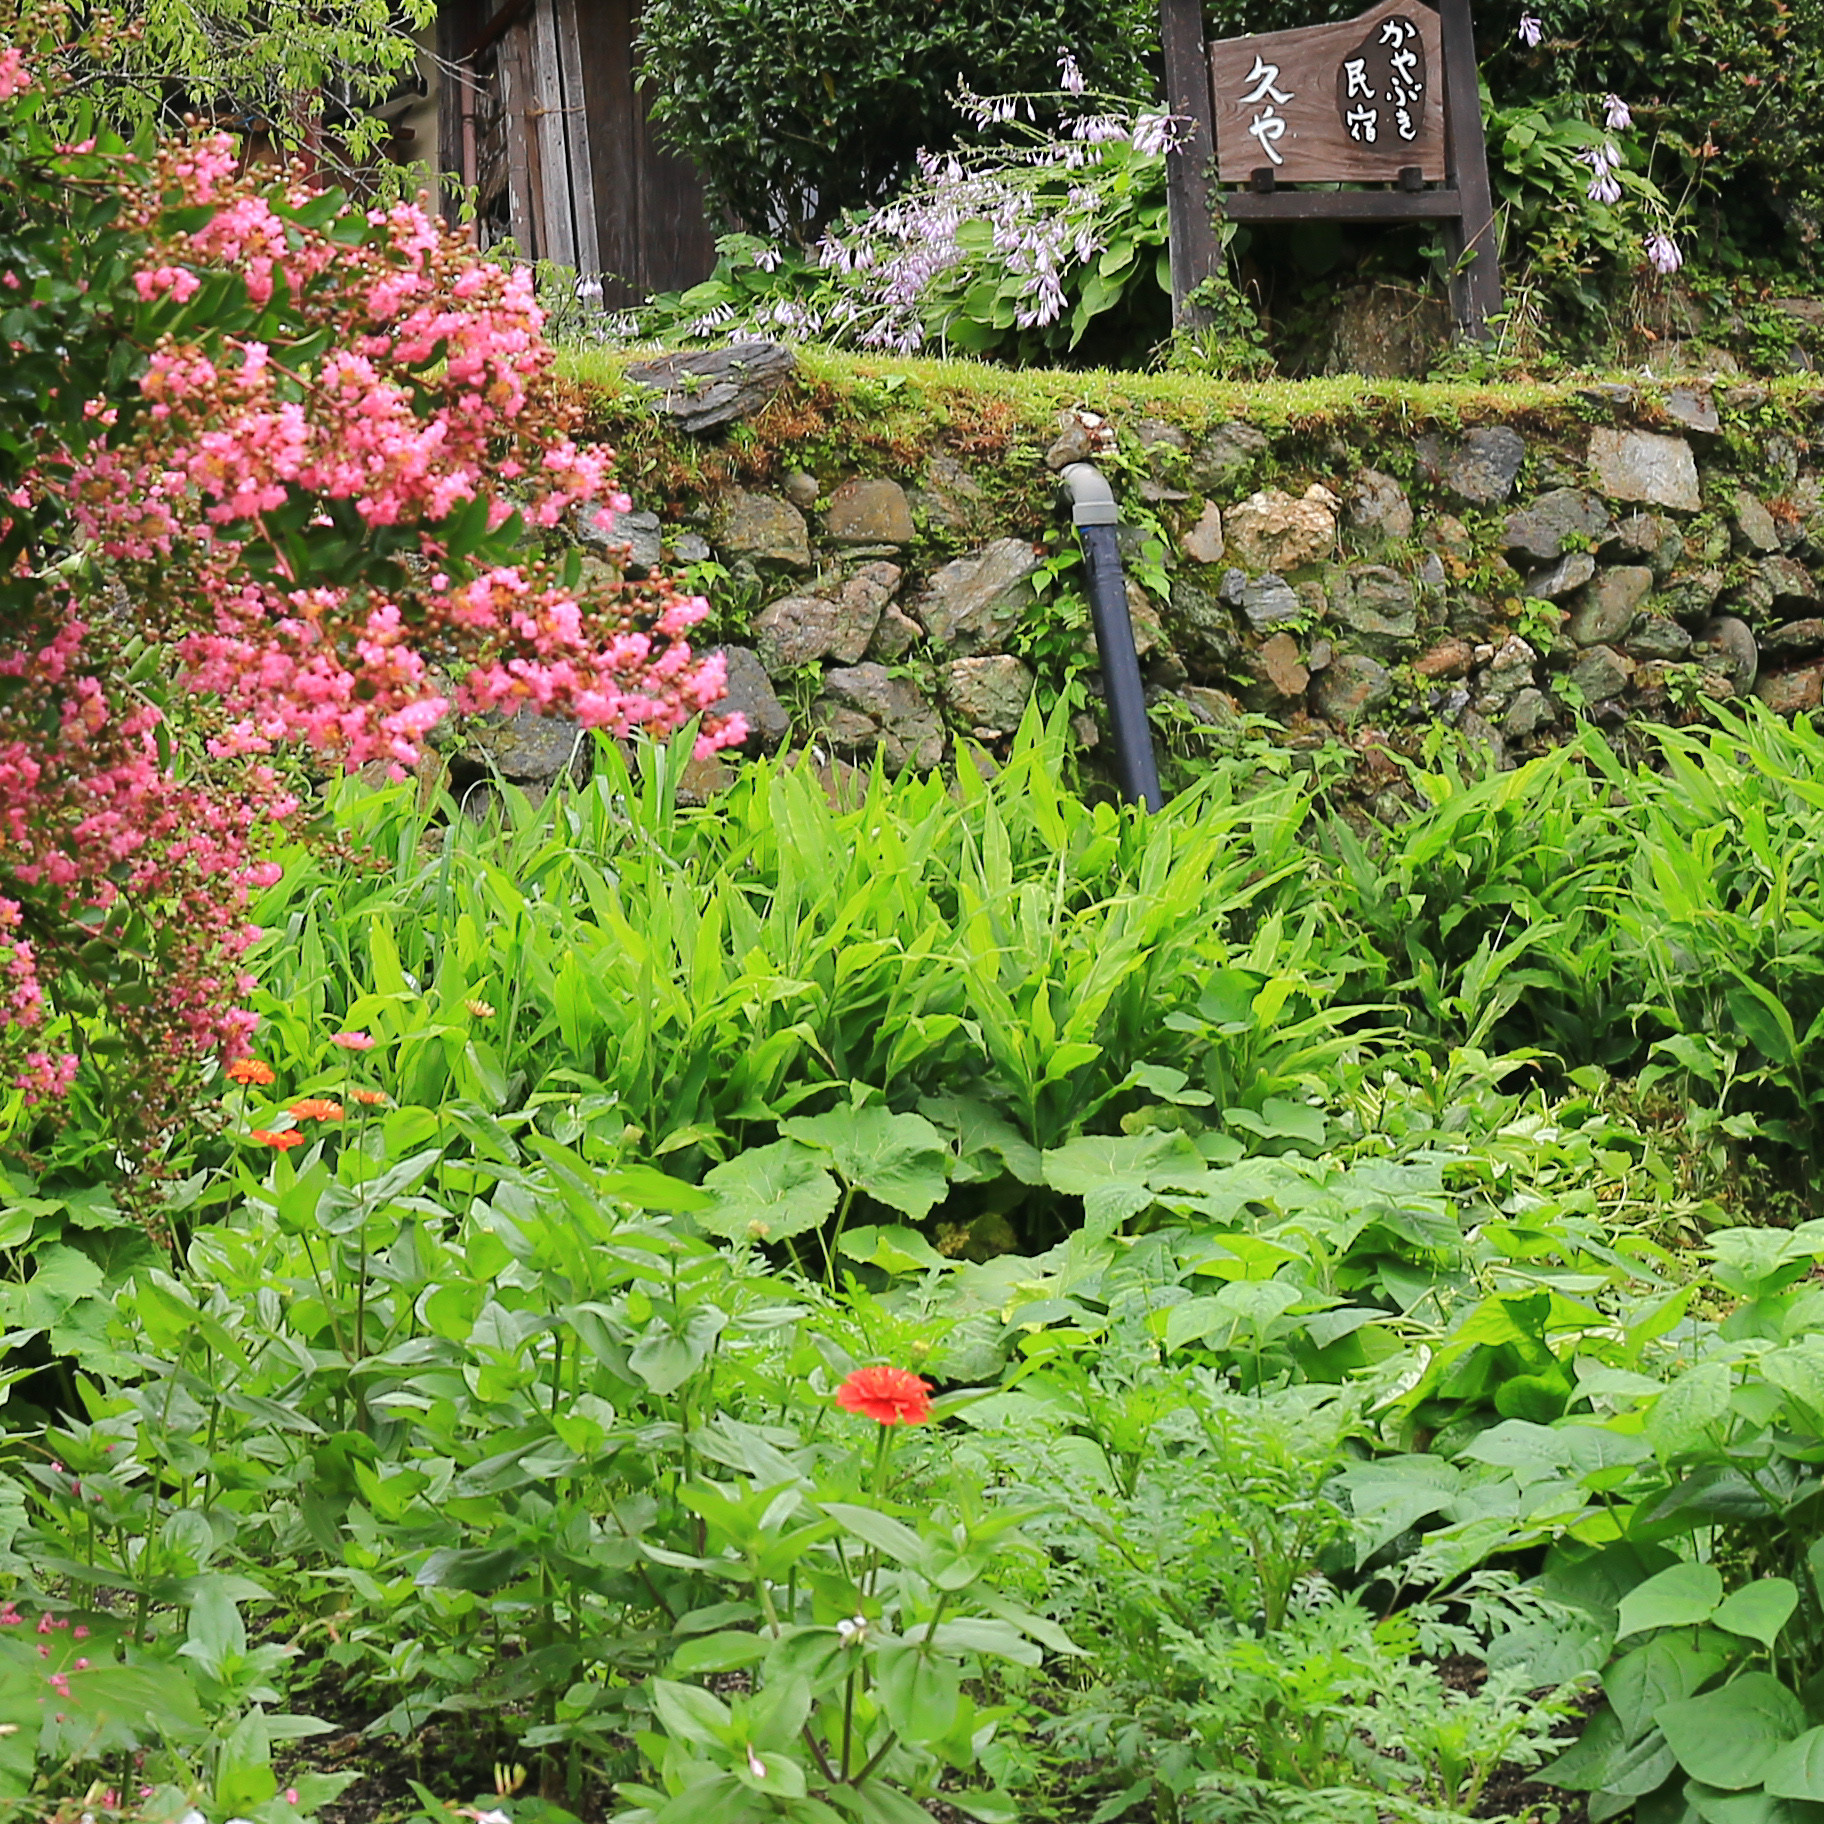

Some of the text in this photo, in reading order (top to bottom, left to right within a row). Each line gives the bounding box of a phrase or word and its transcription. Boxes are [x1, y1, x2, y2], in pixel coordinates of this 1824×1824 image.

[1239, 55, 1295, 166] 久や
[1343, 57, 1378, 144] 民宿
[1378, 19, 1423, 142] かやぶき
